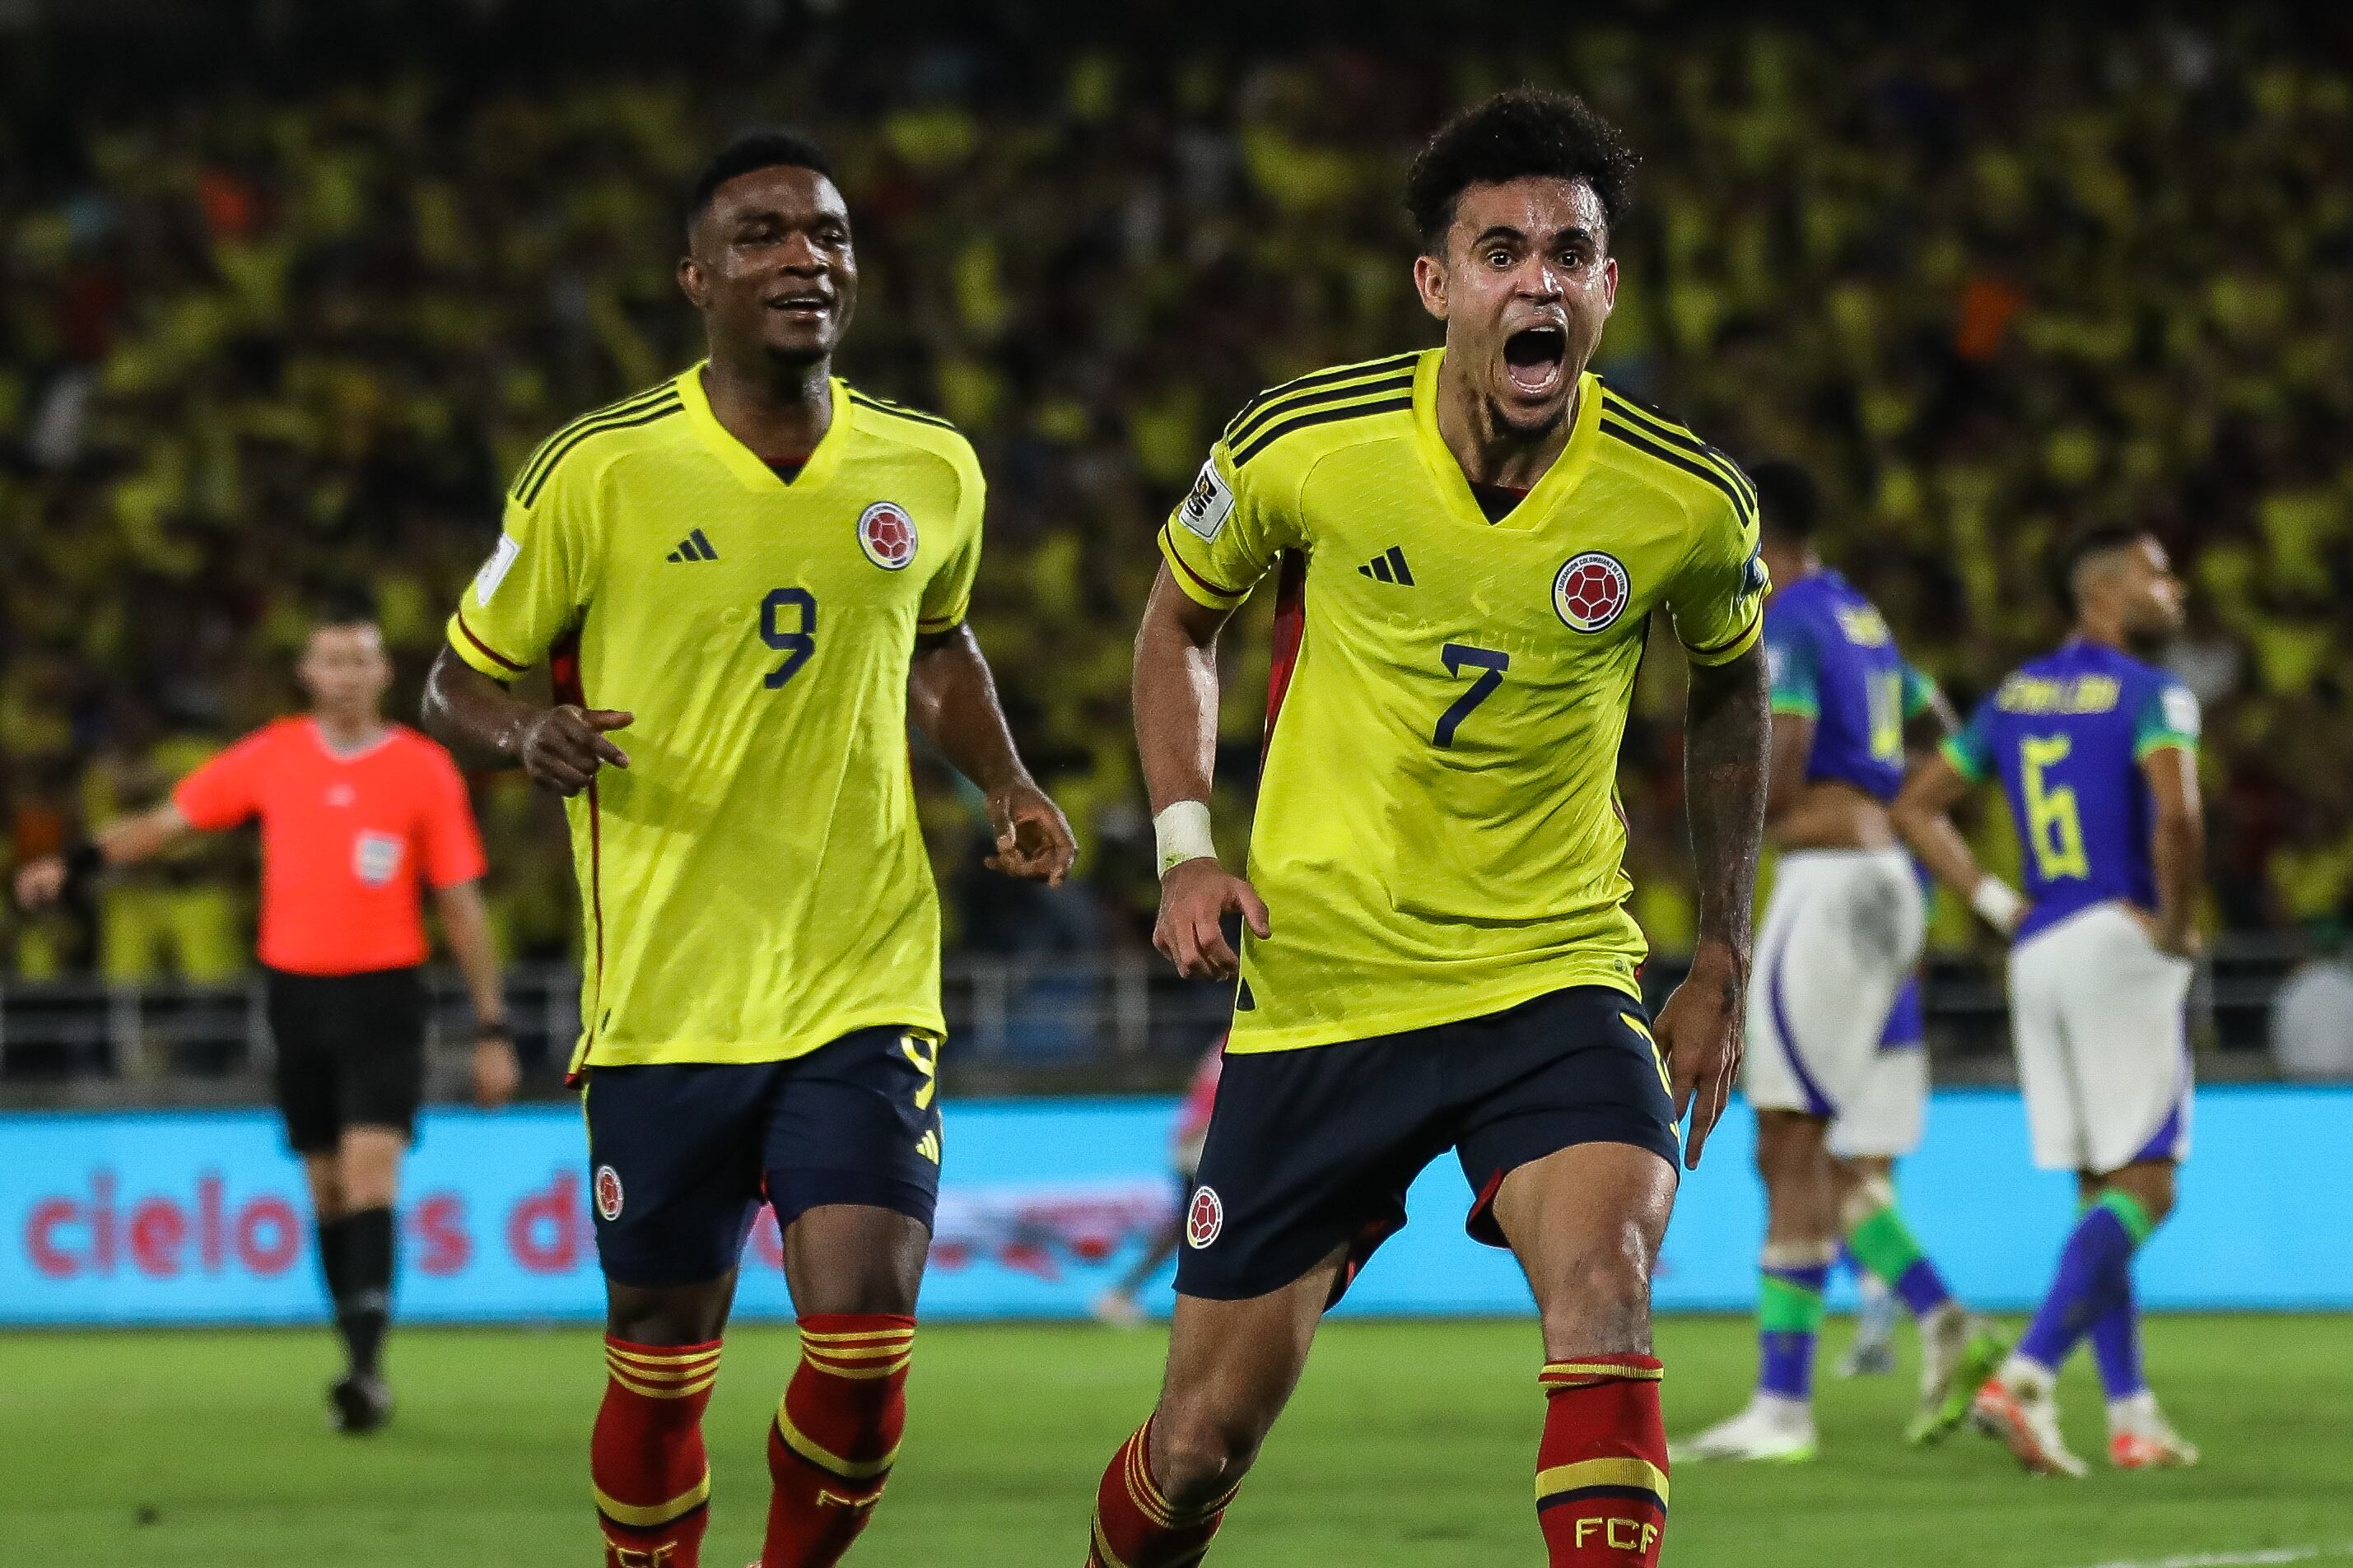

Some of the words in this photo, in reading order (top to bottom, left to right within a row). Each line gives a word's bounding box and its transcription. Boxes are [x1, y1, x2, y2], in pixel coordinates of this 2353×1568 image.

[760, 588, 816, 689] 9
[1433, 643, 1510, 748] 7
[2020, 733, 2091, 882] 6
[900, 1036, 938, 1110] 9
[1576, 1517, 1658, 1554] FCF
